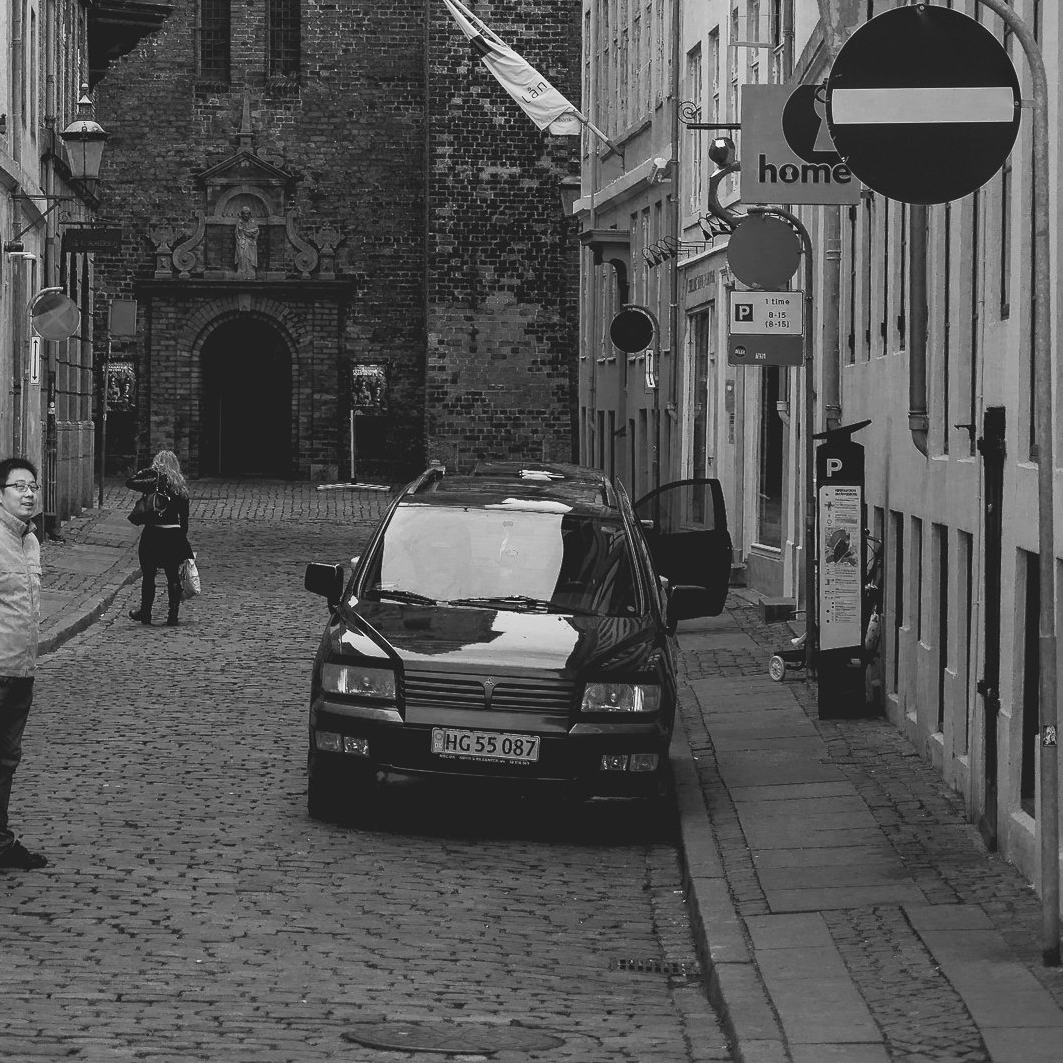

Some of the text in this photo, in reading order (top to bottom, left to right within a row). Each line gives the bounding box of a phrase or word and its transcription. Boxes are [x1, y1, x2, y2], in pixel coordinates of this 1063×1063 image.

[758, 153, 852, 184] home
[739, 305, 750, 320] P
[765, 320, 790, 328] (8-15)
[826, 458, 843, 477] P
[445, 733, 536, 757] HG 55 087
